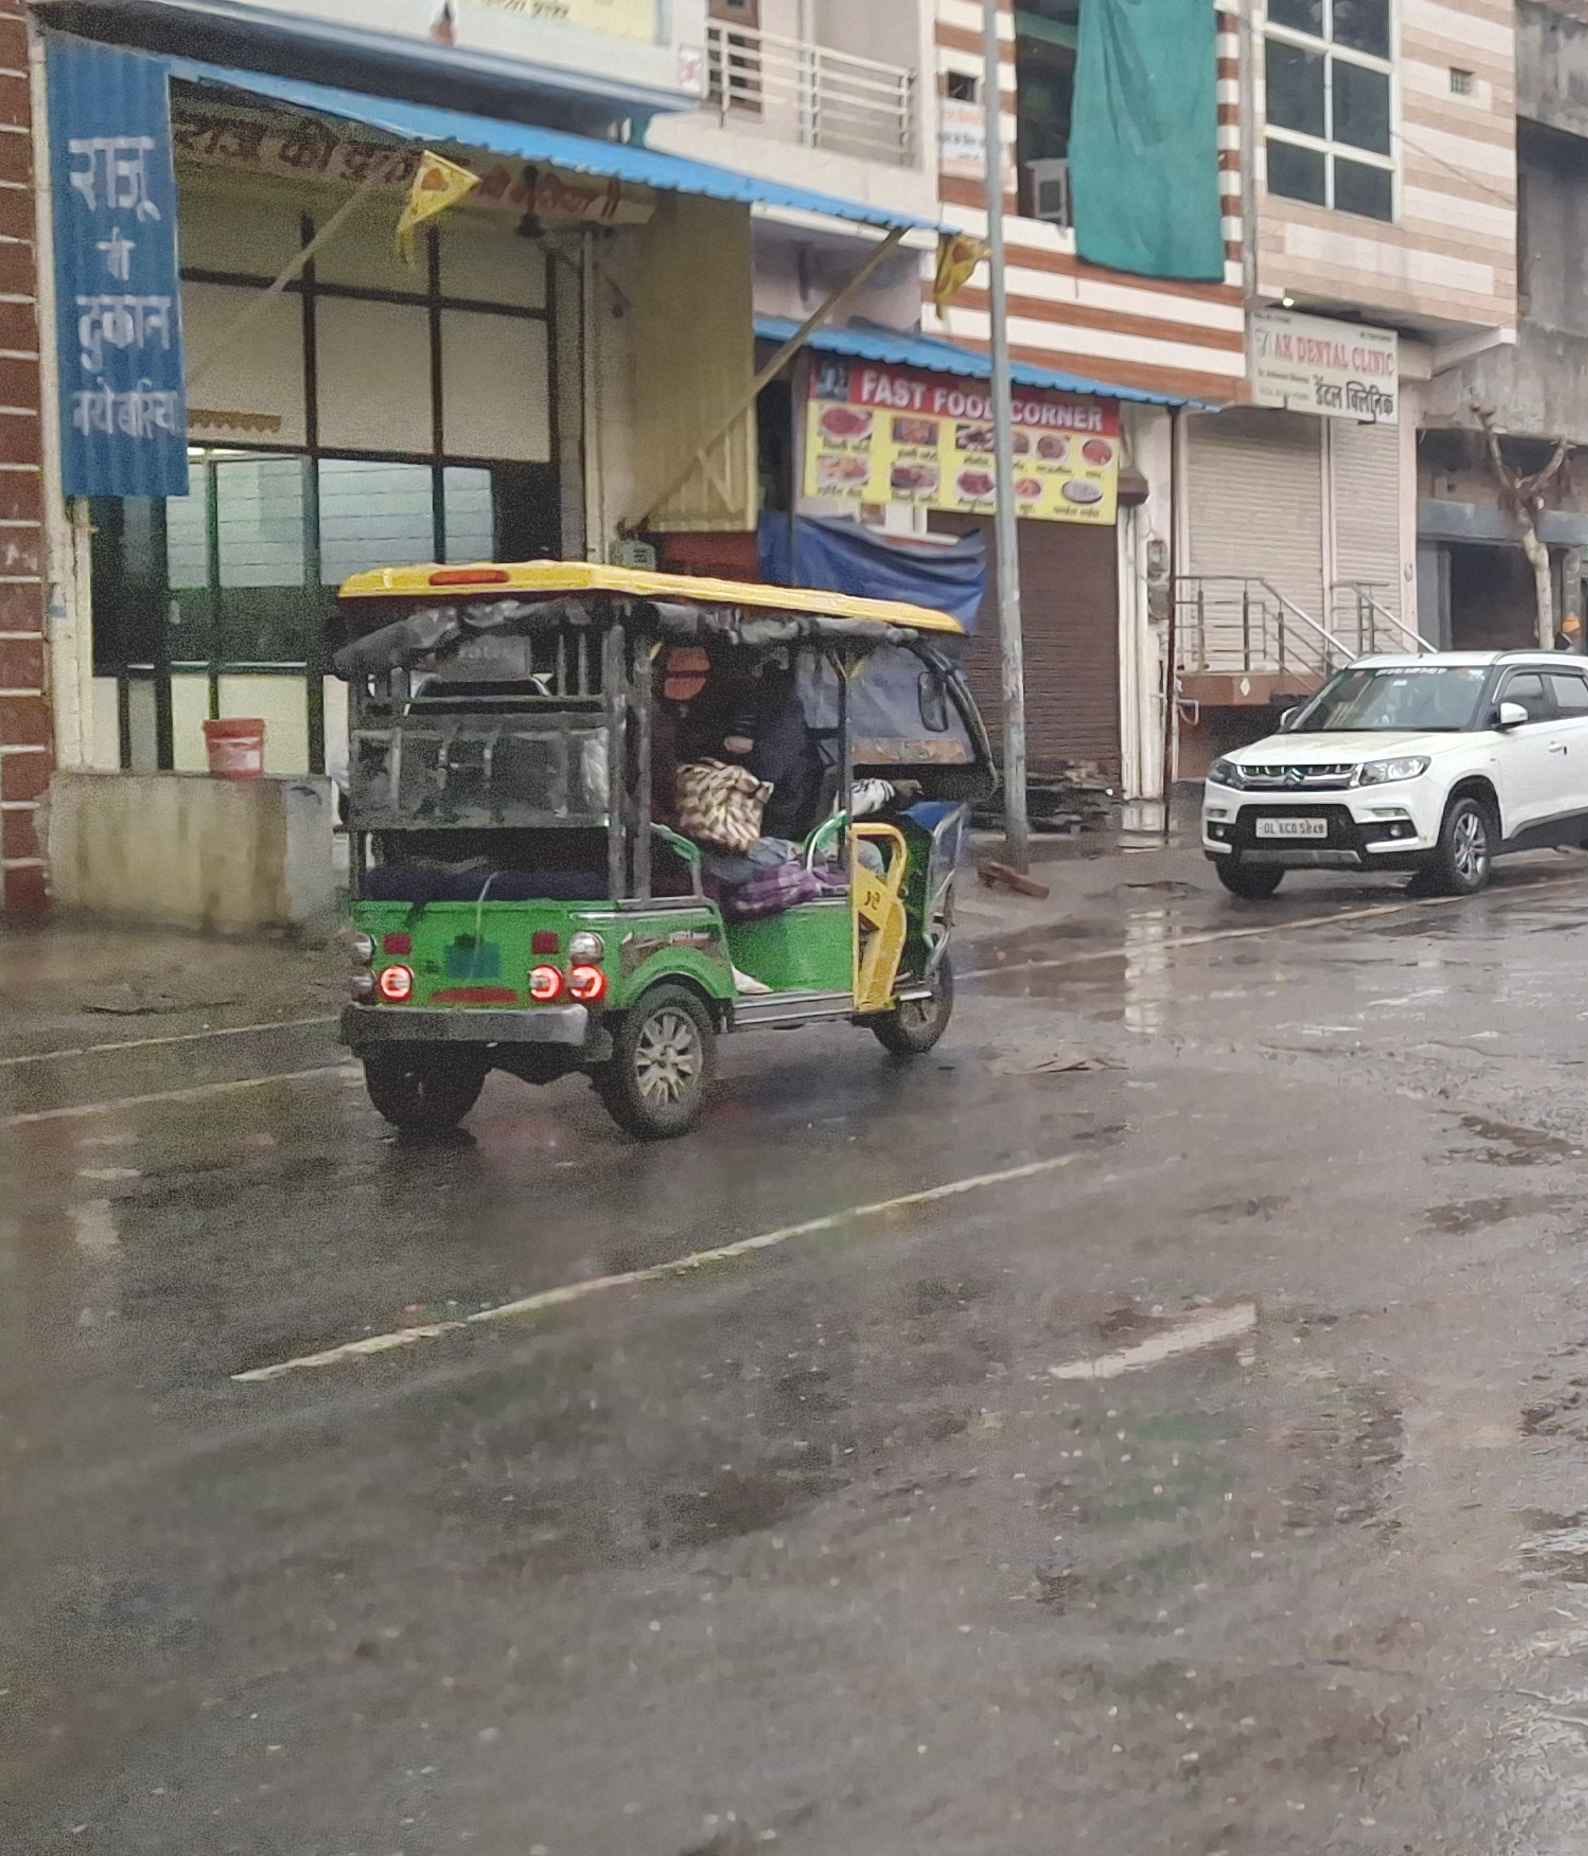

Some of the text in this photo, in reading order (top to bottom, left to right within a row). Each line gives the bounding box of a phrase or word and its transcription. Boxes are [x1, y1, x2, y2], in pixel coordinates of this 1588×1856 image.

[68, 136, 161, 222] राजू
[75, 294, 171, 374] दुकान
[1275, 333, 1395, 377] AK DENTAL CLINIC
[861, 368, 927, 411] FAST
[1010, 400, 1103, 432] CORNER
